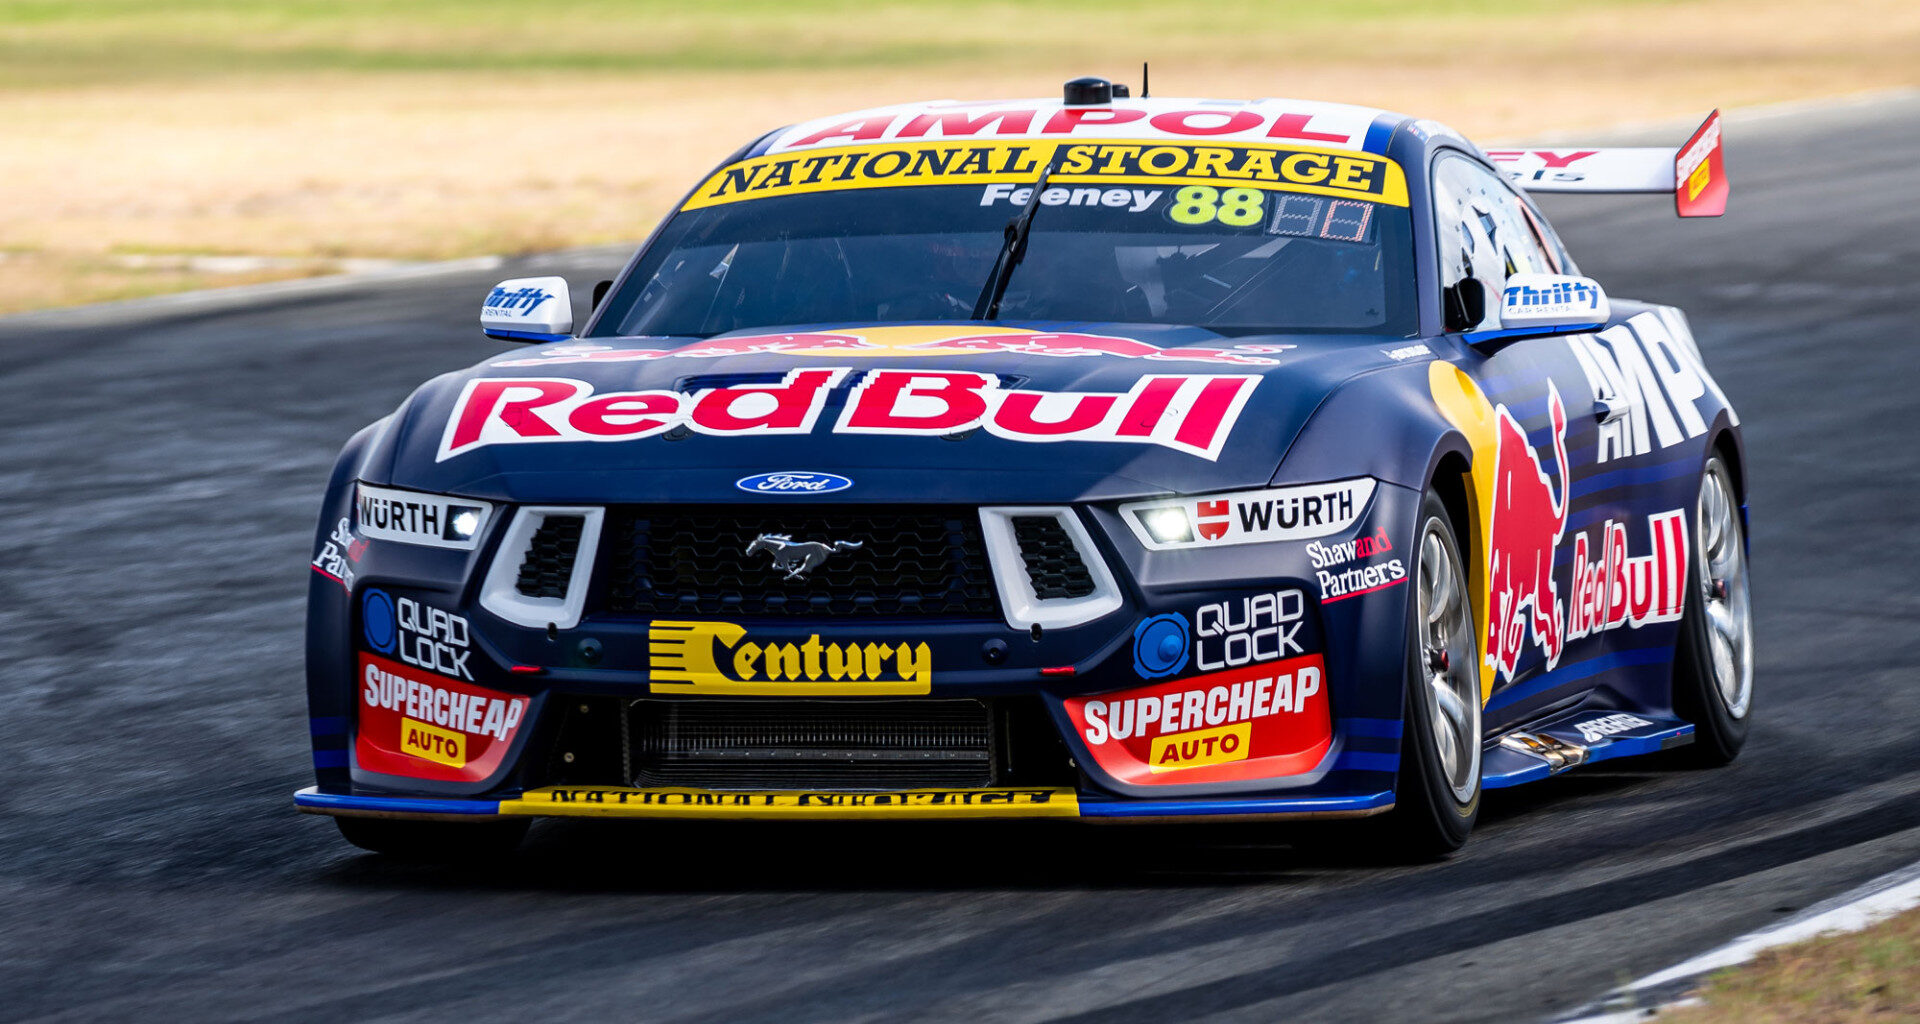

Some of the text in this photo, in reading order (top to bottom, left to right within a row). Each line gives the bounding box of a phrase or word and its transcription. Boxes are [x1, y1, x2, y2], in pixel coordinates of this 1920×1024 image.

[786, 109, 1350, 147] AMPOL
[709, 145, 1374, 198] NATIONAL STORAGE
[980, 184, 1265, 227] Feeney 88
[1503, 282, 1598, 309] Thrifty
[438, 367, 1262, 460] Red Bull
[757, 474, 830, 490] Ford
[360, 496, 439, 535] WÜRTH
[1238, 489, 1353, 532] WÜRTH
[1316, 558, 1406, 600] Partners
[1567, 510, 1687, 639] Red Bull
[398, 598, 470, 647] QUAD
[1197, 589, 1304, 636] QUAD
[398, 630, 475, 681] LOCK
[649, 620, 931, 696] Century
[1197, 621, 1304, 671] LOCK
[365, 663, 522, 741] SUPERCHEAP
[1084, 667, 1321, 745] SUPERCHEAP
[407, 729, 459, 759] AUTO
[1159, 733, 1240, 764] AUTO
